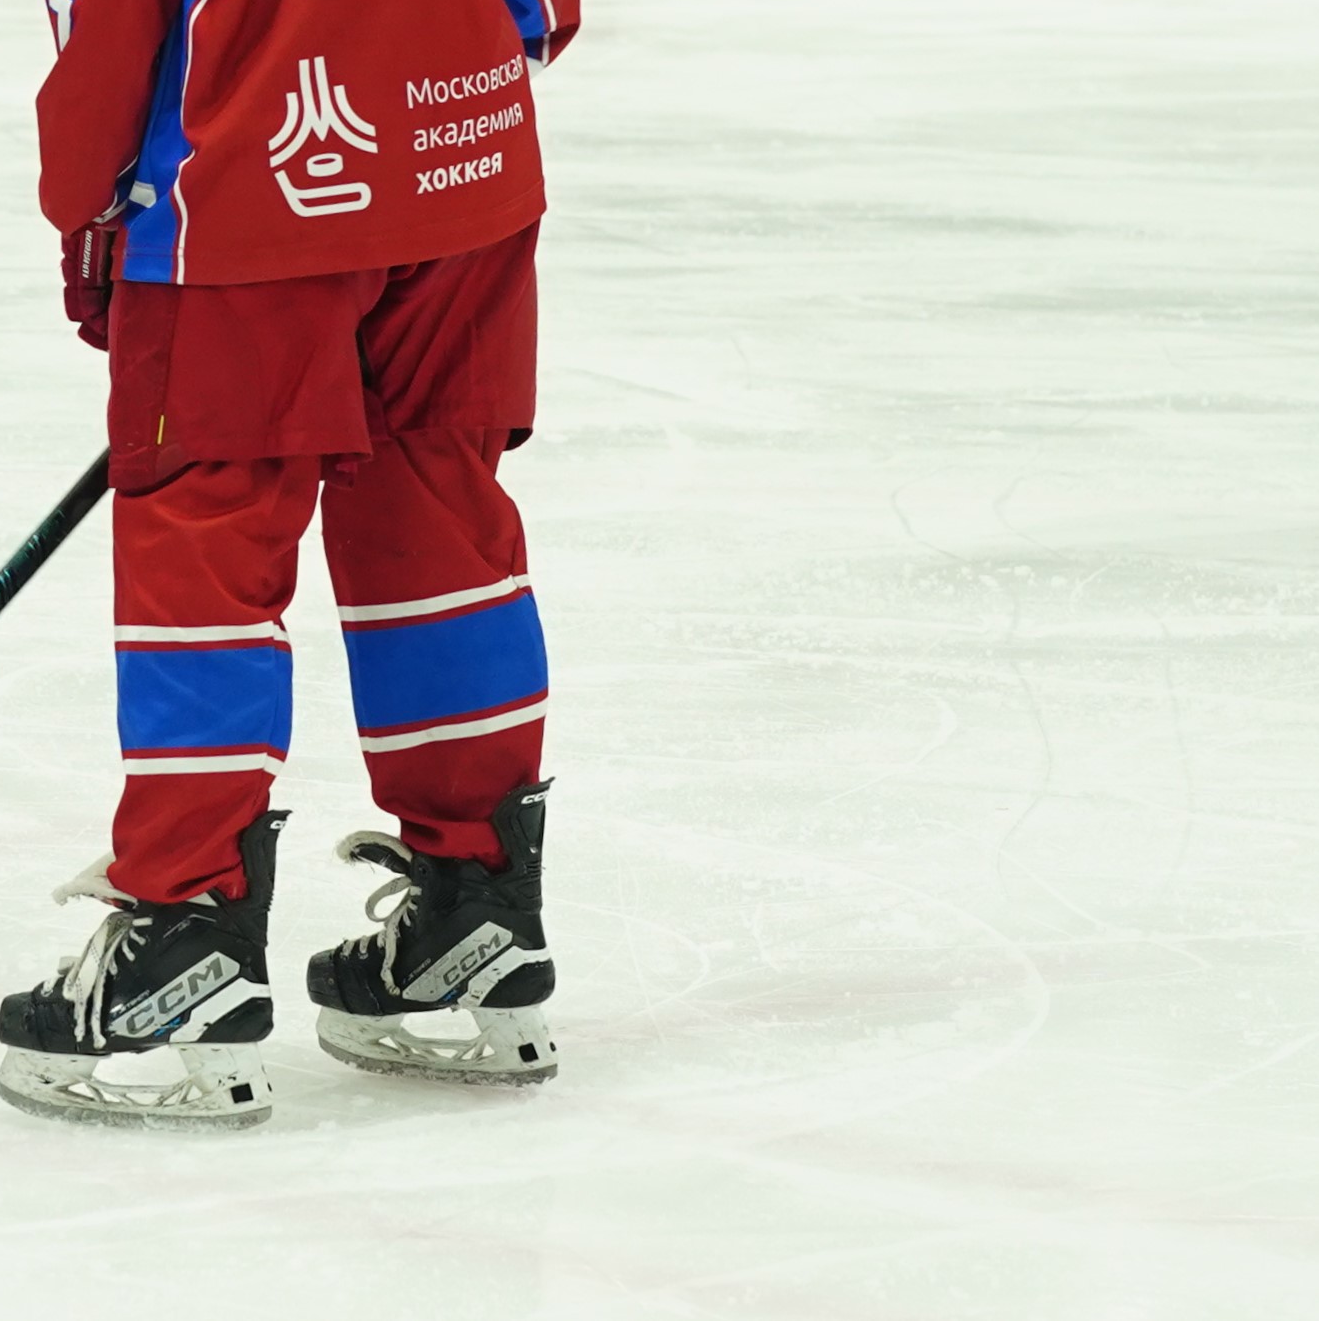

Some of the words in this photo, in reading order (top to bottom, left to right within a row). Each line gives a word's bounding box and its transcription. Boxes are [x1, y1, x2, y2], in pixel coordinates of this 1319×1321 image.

[406, 54, 524, 109] Московская
[413, 102, 524, 152] академия
[415, 152, 503, 195] хоккея
[520, 792, 551, 805] CC
[442, 932, 502, 986] CCM
[125, 956, 224, 1036] CCM
